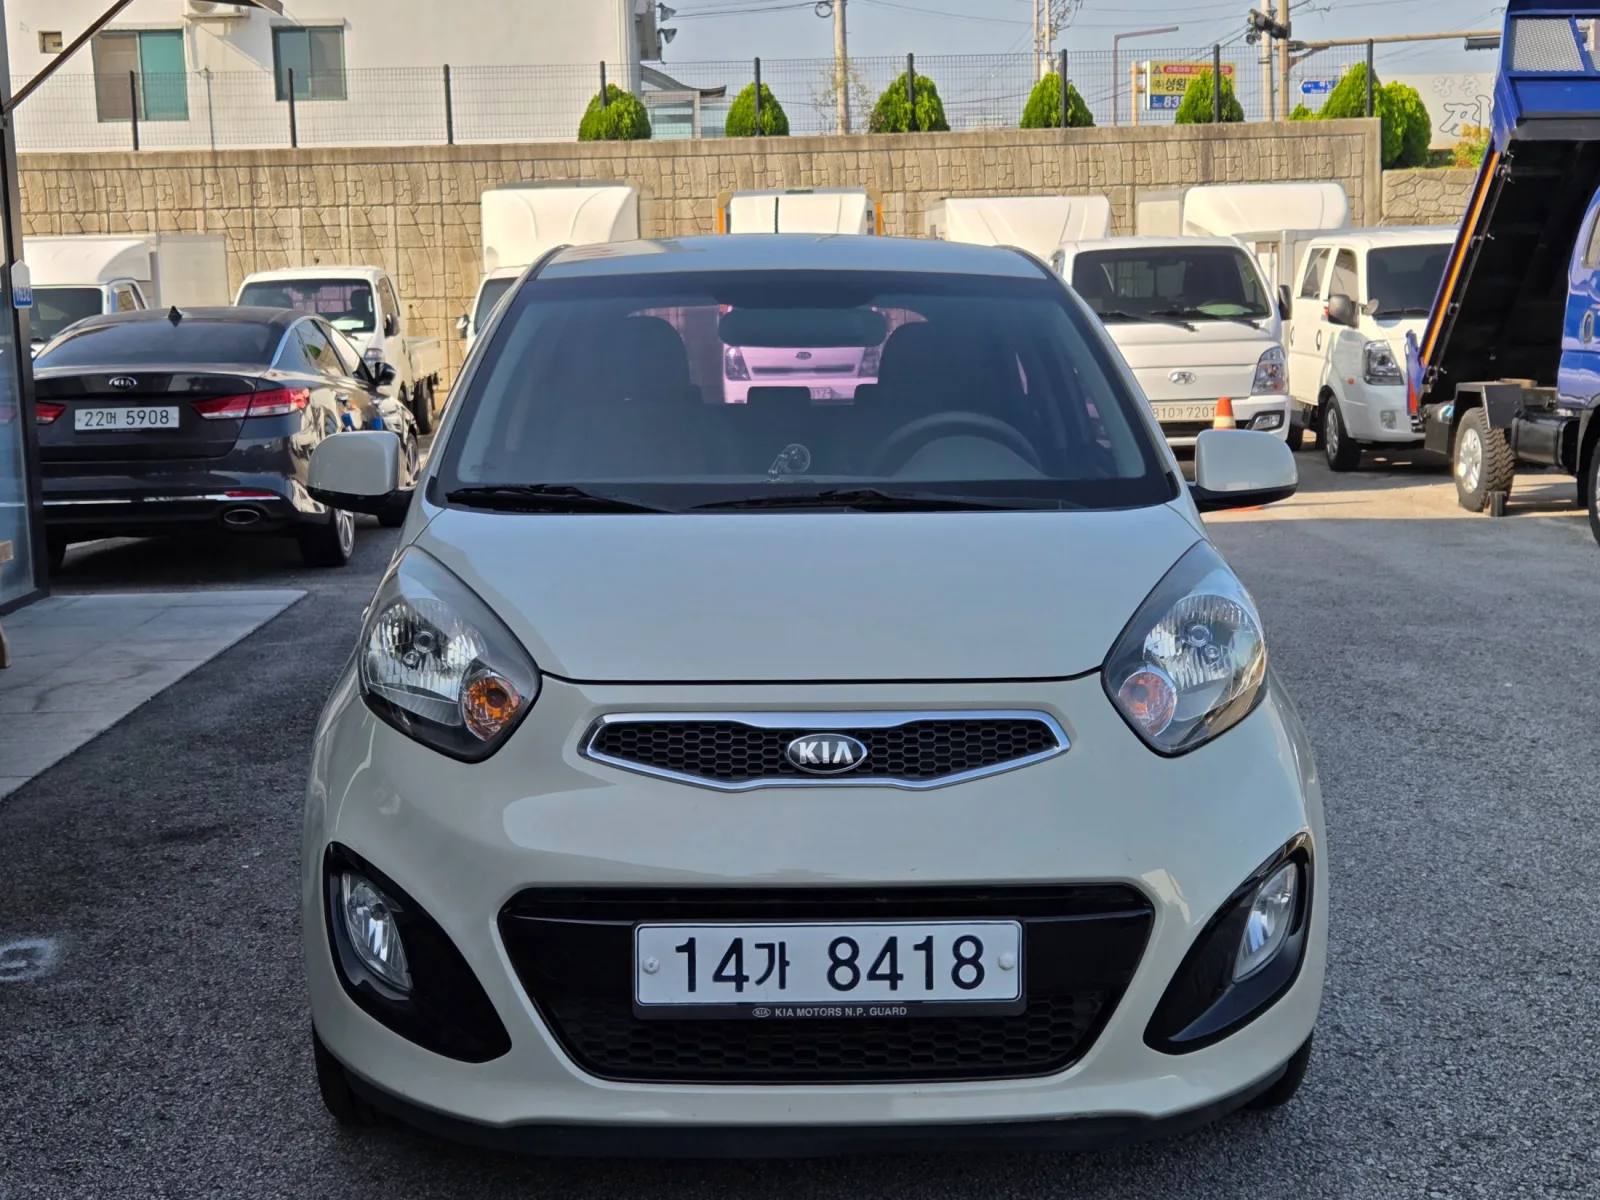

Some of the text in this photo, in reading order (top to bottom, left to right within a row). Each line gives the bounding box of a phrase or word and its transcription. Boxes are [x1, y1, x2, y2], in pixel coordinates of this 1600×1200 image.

[84, 409, 170, 427] 22머 5908
[1186, 406, 1215, 419] 7201
[798, 741, 854, 764] KIA
[675, 934, 986, 993] 14가 8418
[775, 1007, 794, 1017] KIA
[796, 1007, 842, 1017] MOTORS
[845, 1007, 866, 1017] N.P.
[869, 1006, 907, 1017] GUARD
